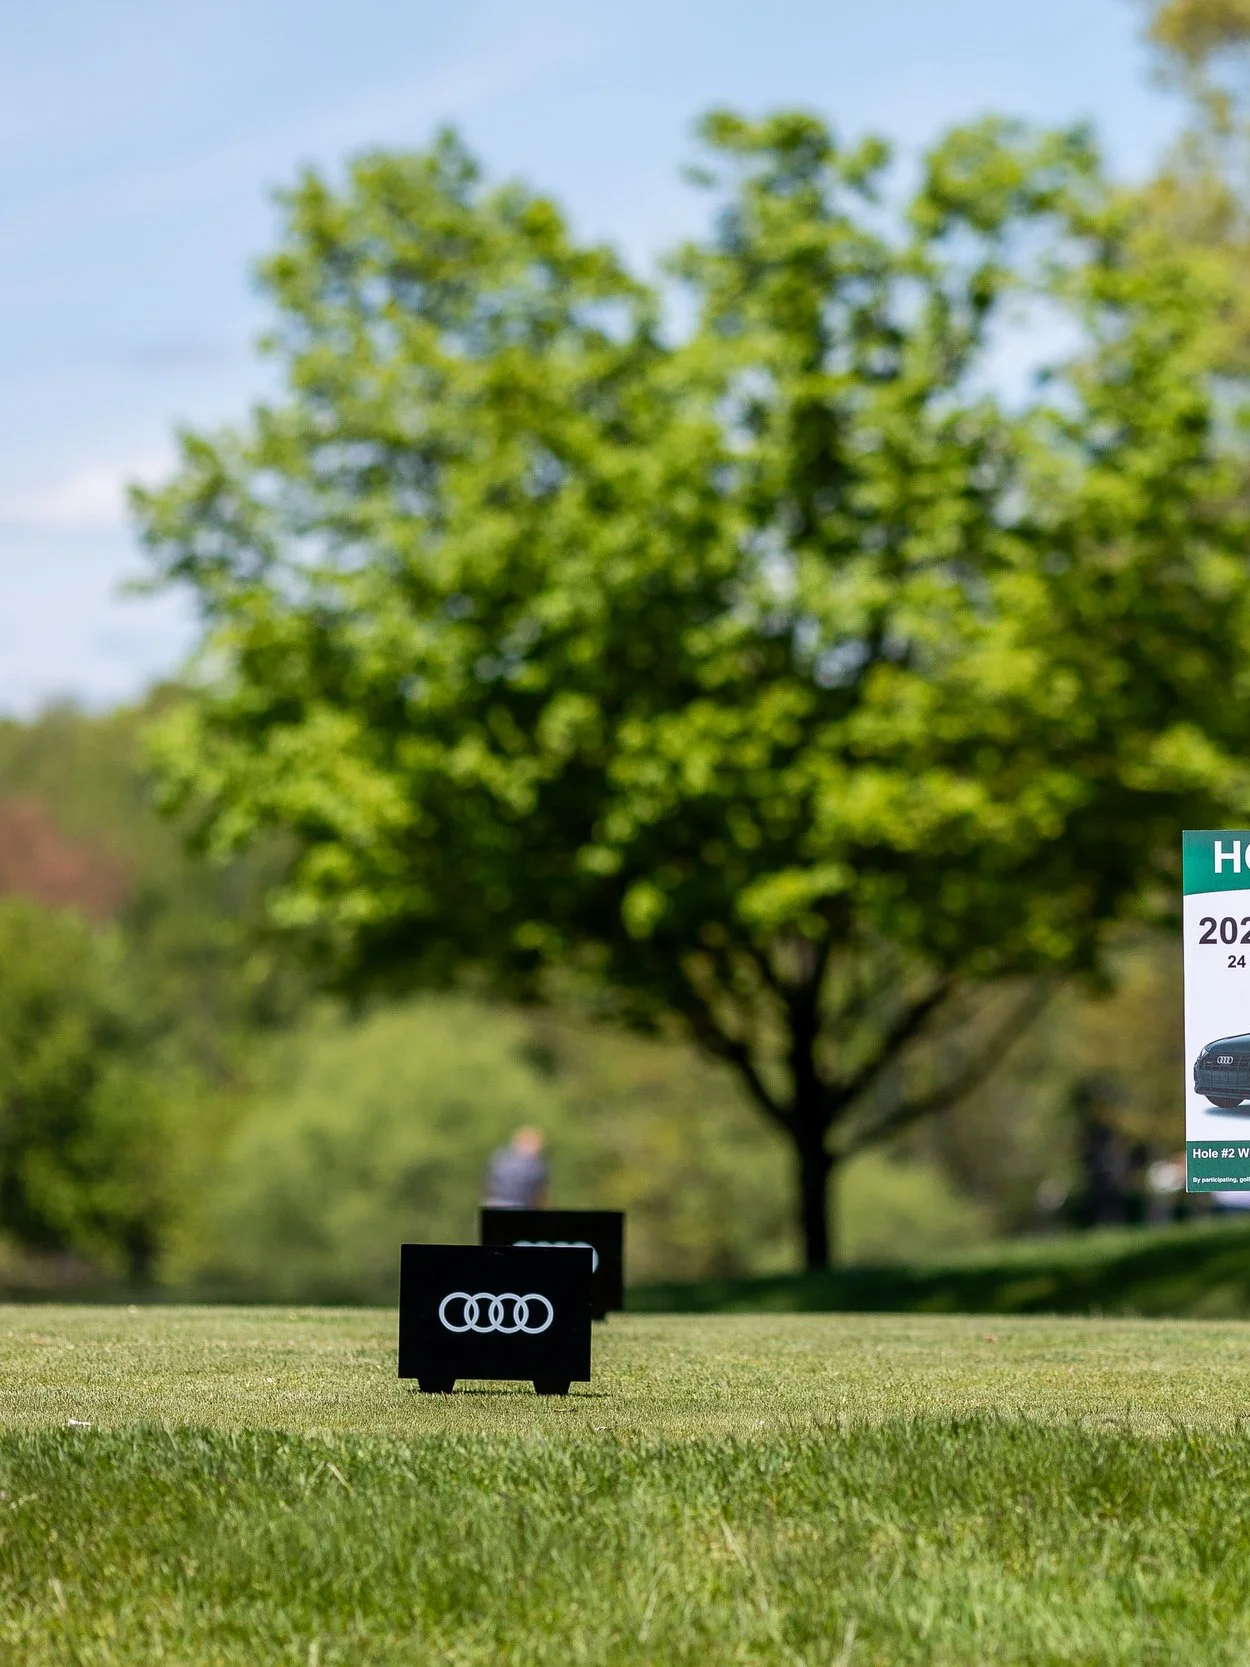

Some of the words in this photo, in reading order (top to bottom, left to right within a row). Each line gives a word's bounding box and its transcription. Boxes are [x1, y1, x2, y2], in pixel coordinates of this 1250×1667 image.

[1228, 955, 1246, 968] 24
[1193, 1148, 1218, 1158] Hole
[1221, 1148, 1235, 1158] #2
